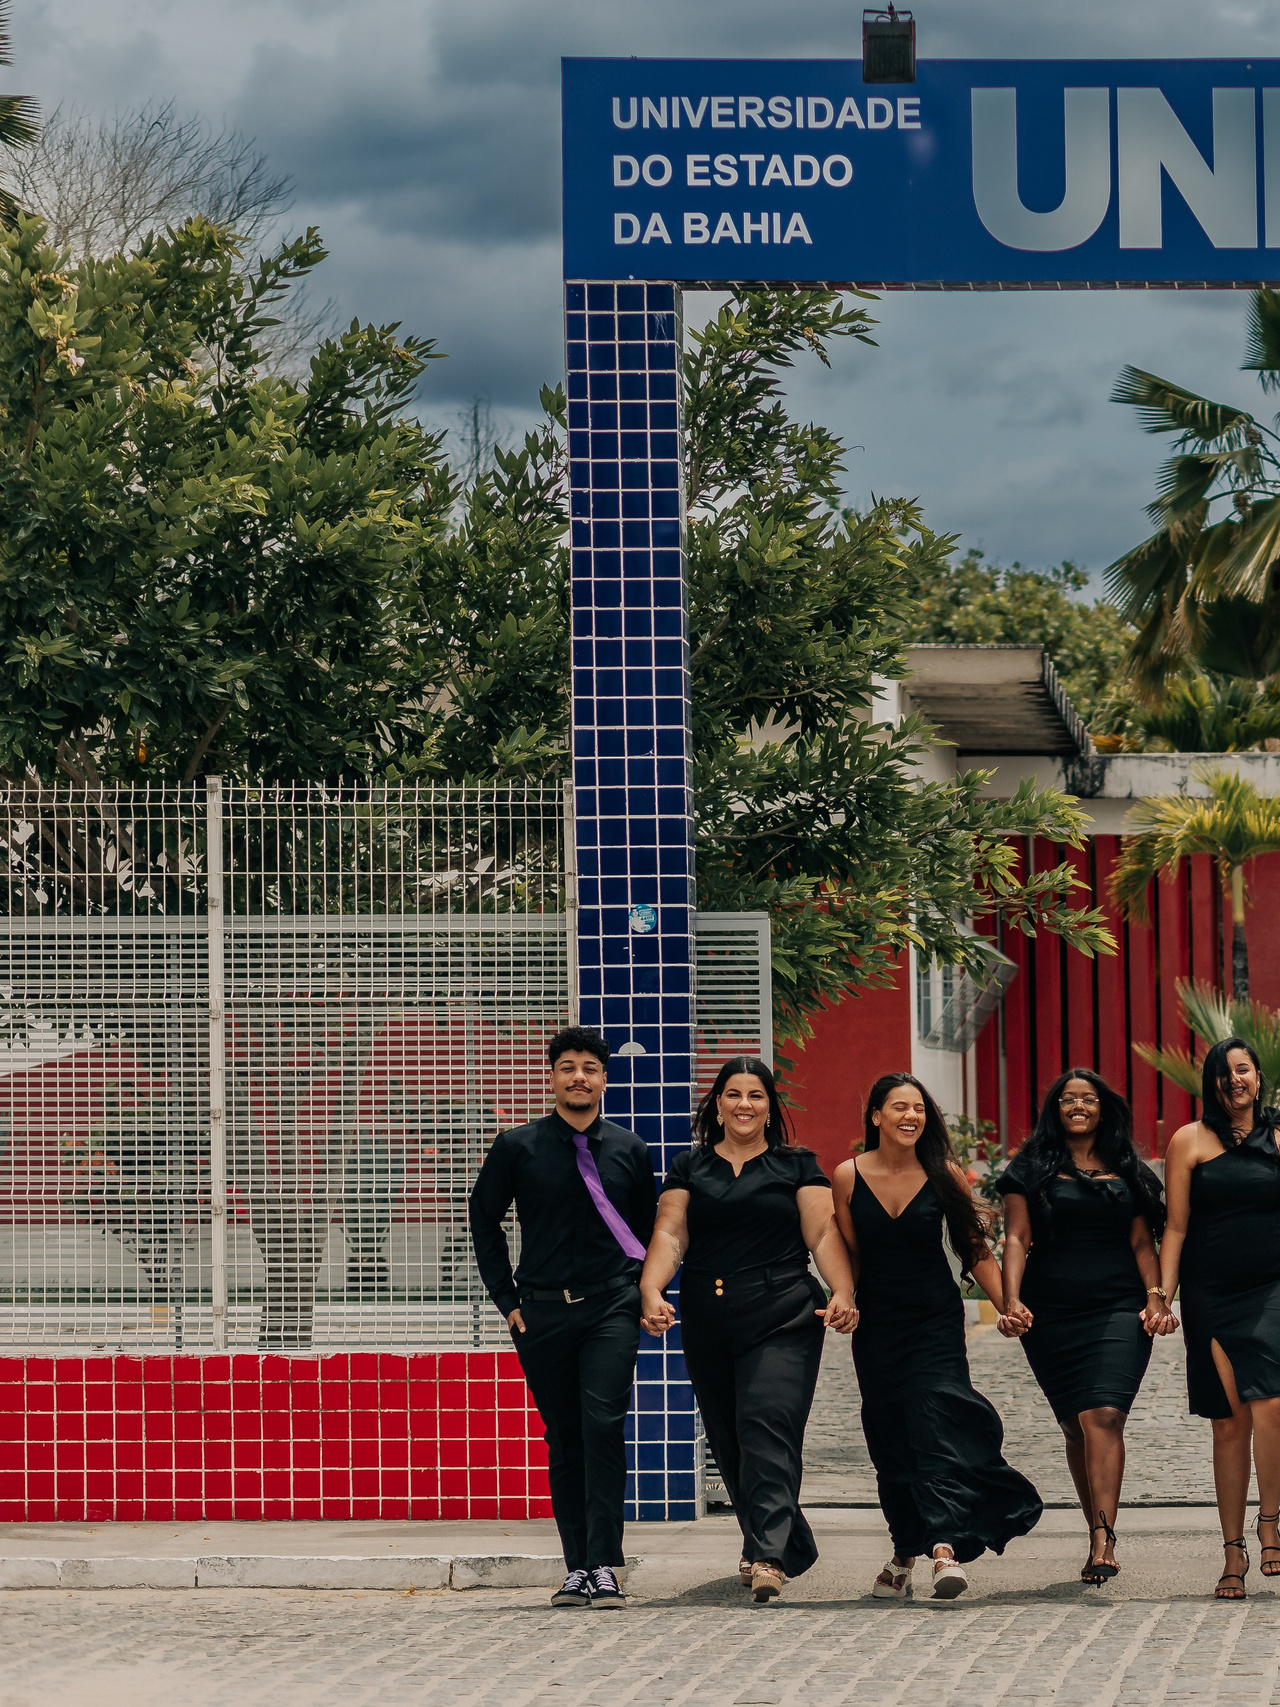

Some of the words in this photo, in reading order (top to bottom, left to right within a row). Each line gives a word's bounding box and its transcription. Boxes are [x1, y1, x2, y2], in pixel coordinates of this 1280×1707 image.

[612, 96, 921, 130] UNIVERSIDADE
[612, 154, 673, 188] DO
[686, 153, 853, 188] ESTADO
[613, 212, 673, 245] DA
[683, 212, 813, 245] BAHIA
